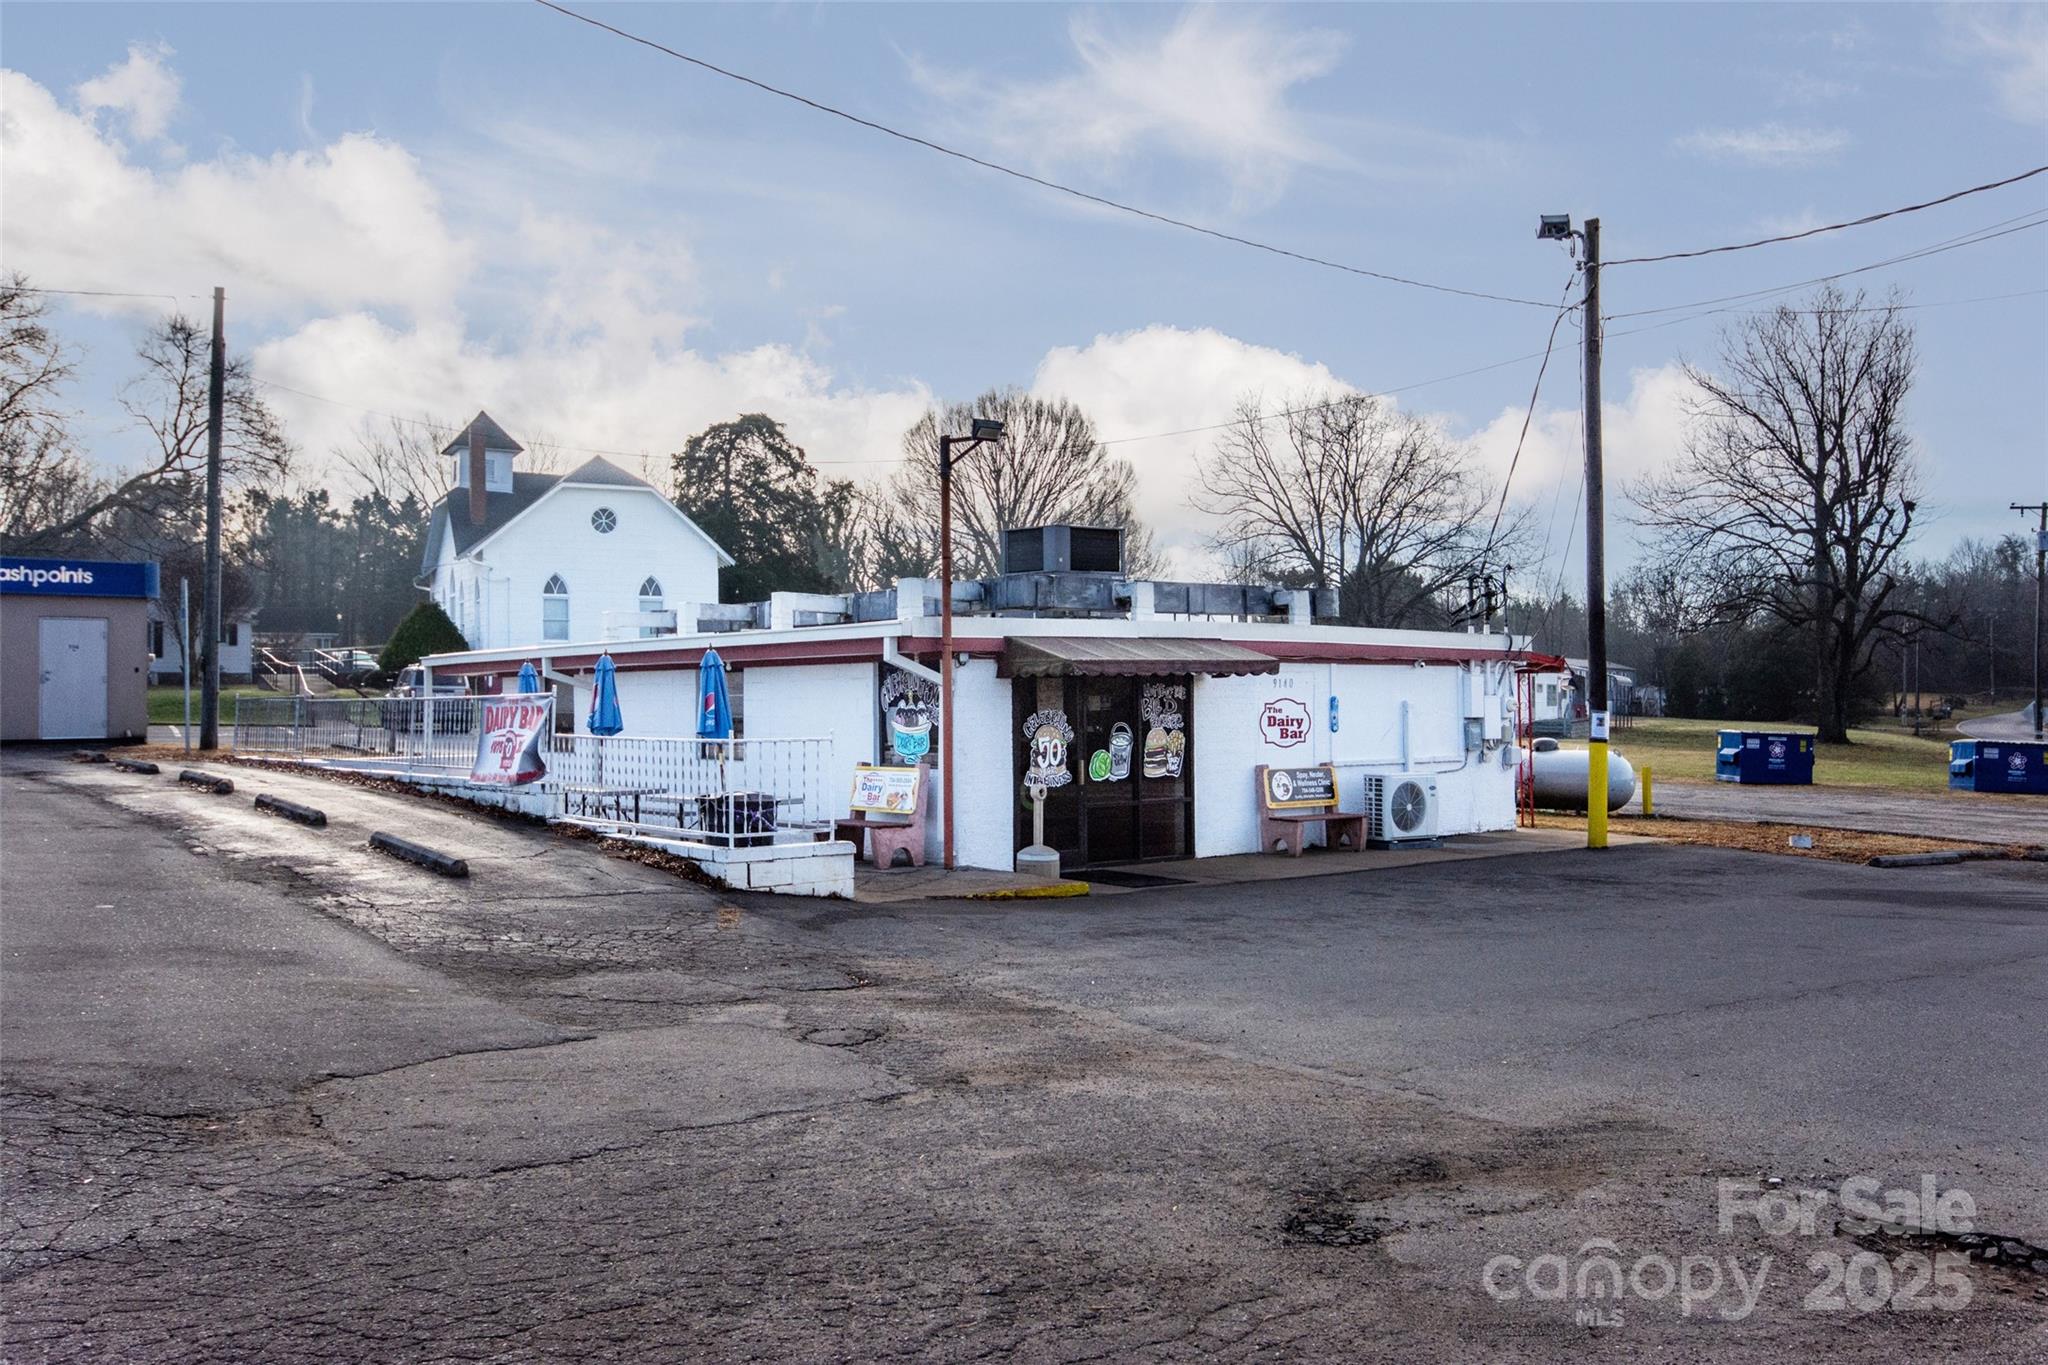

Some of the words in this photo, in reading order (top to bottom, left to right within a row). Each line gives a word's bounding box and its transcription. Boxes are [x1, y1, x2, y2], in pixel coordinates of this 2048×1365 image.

[1267, 715, 1304, 729] Dairy
[1280, 728, 1304, 739] Bar
[1037, 736, 1062, 769] 50
[862, 782, 883, 794] Dairy
[867, 792, 880, 801] Bar
